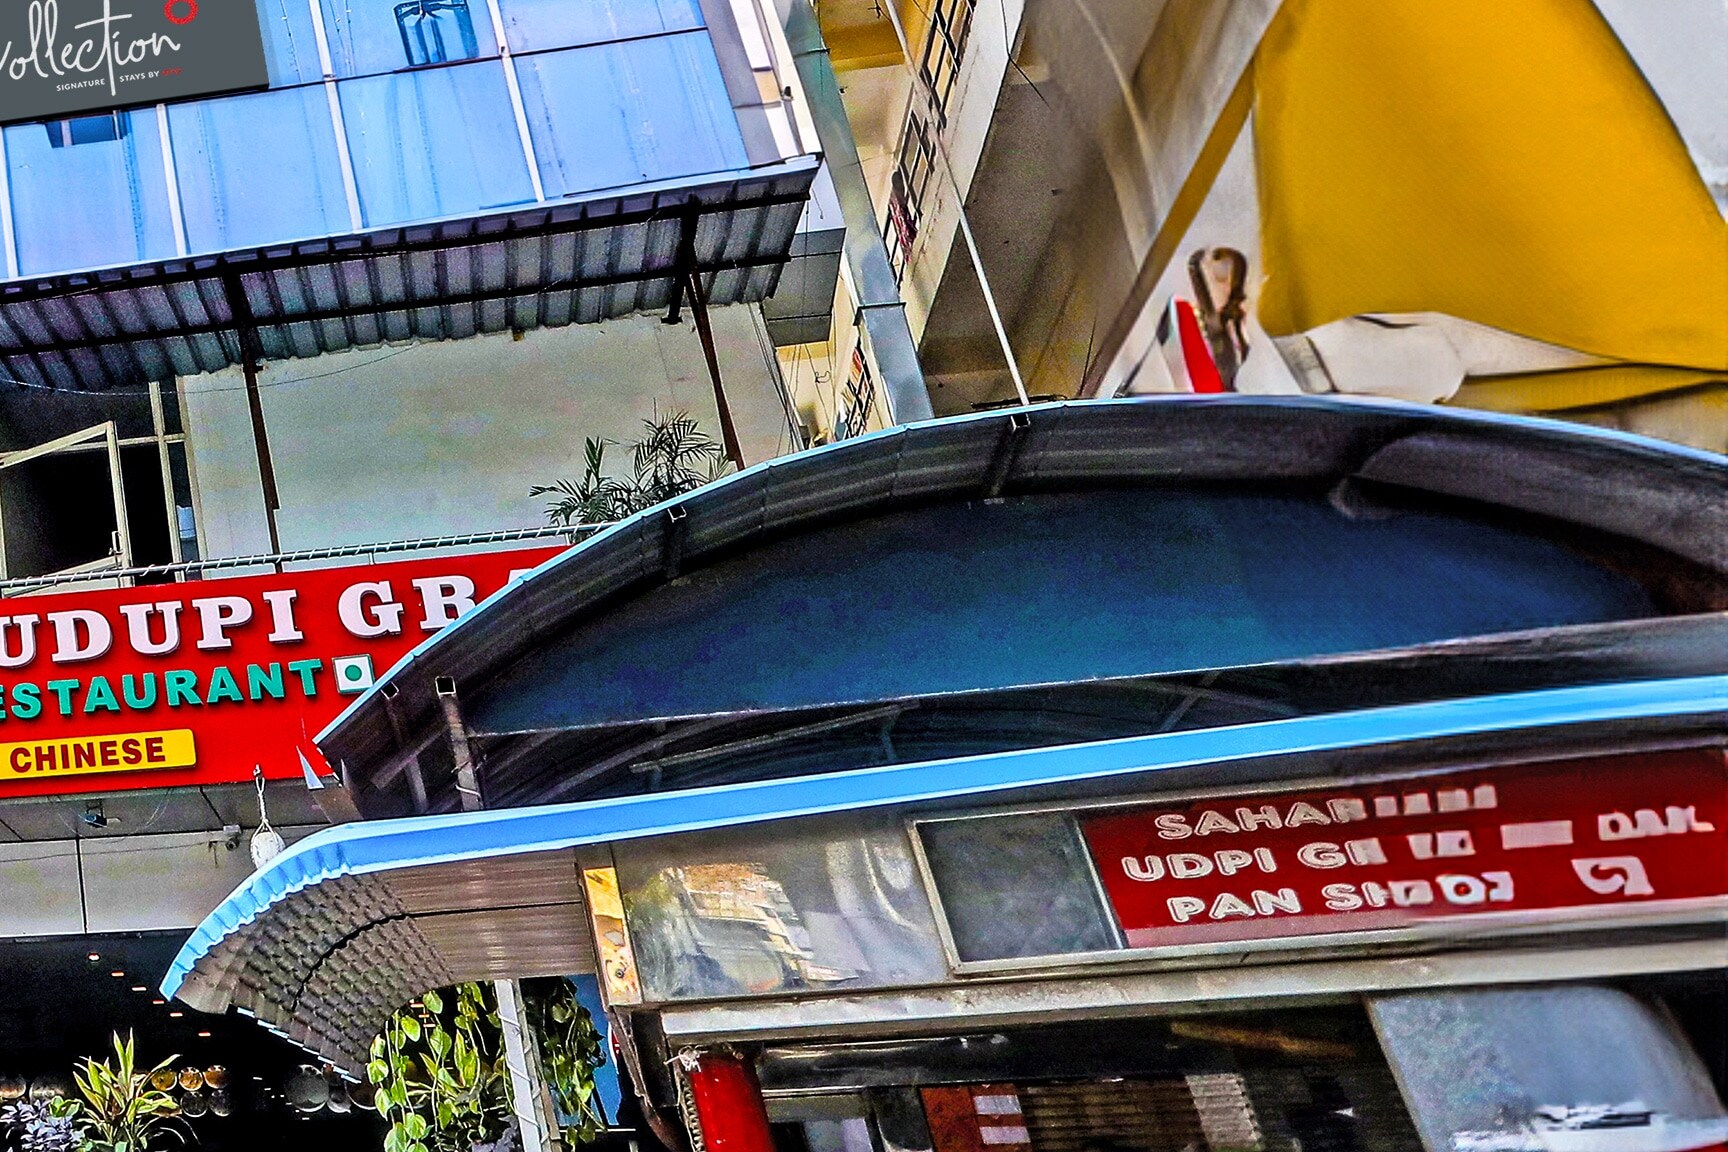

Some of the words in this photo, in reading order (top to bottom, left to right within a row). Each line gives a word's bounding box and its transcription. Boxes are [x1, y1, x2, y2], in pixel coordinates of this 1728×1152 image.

[56, 78, 106, 92] SIGNATURE
[119, 72, 147, 83] STAYS
[148, 70, 160, 79] BY
[337, 568, 529, 637] GR
[9, 736, 167, 773] CHINESE
[1121, 847, 1278, 881] UDPI
[1166, 887, 1303, 923] PAN
